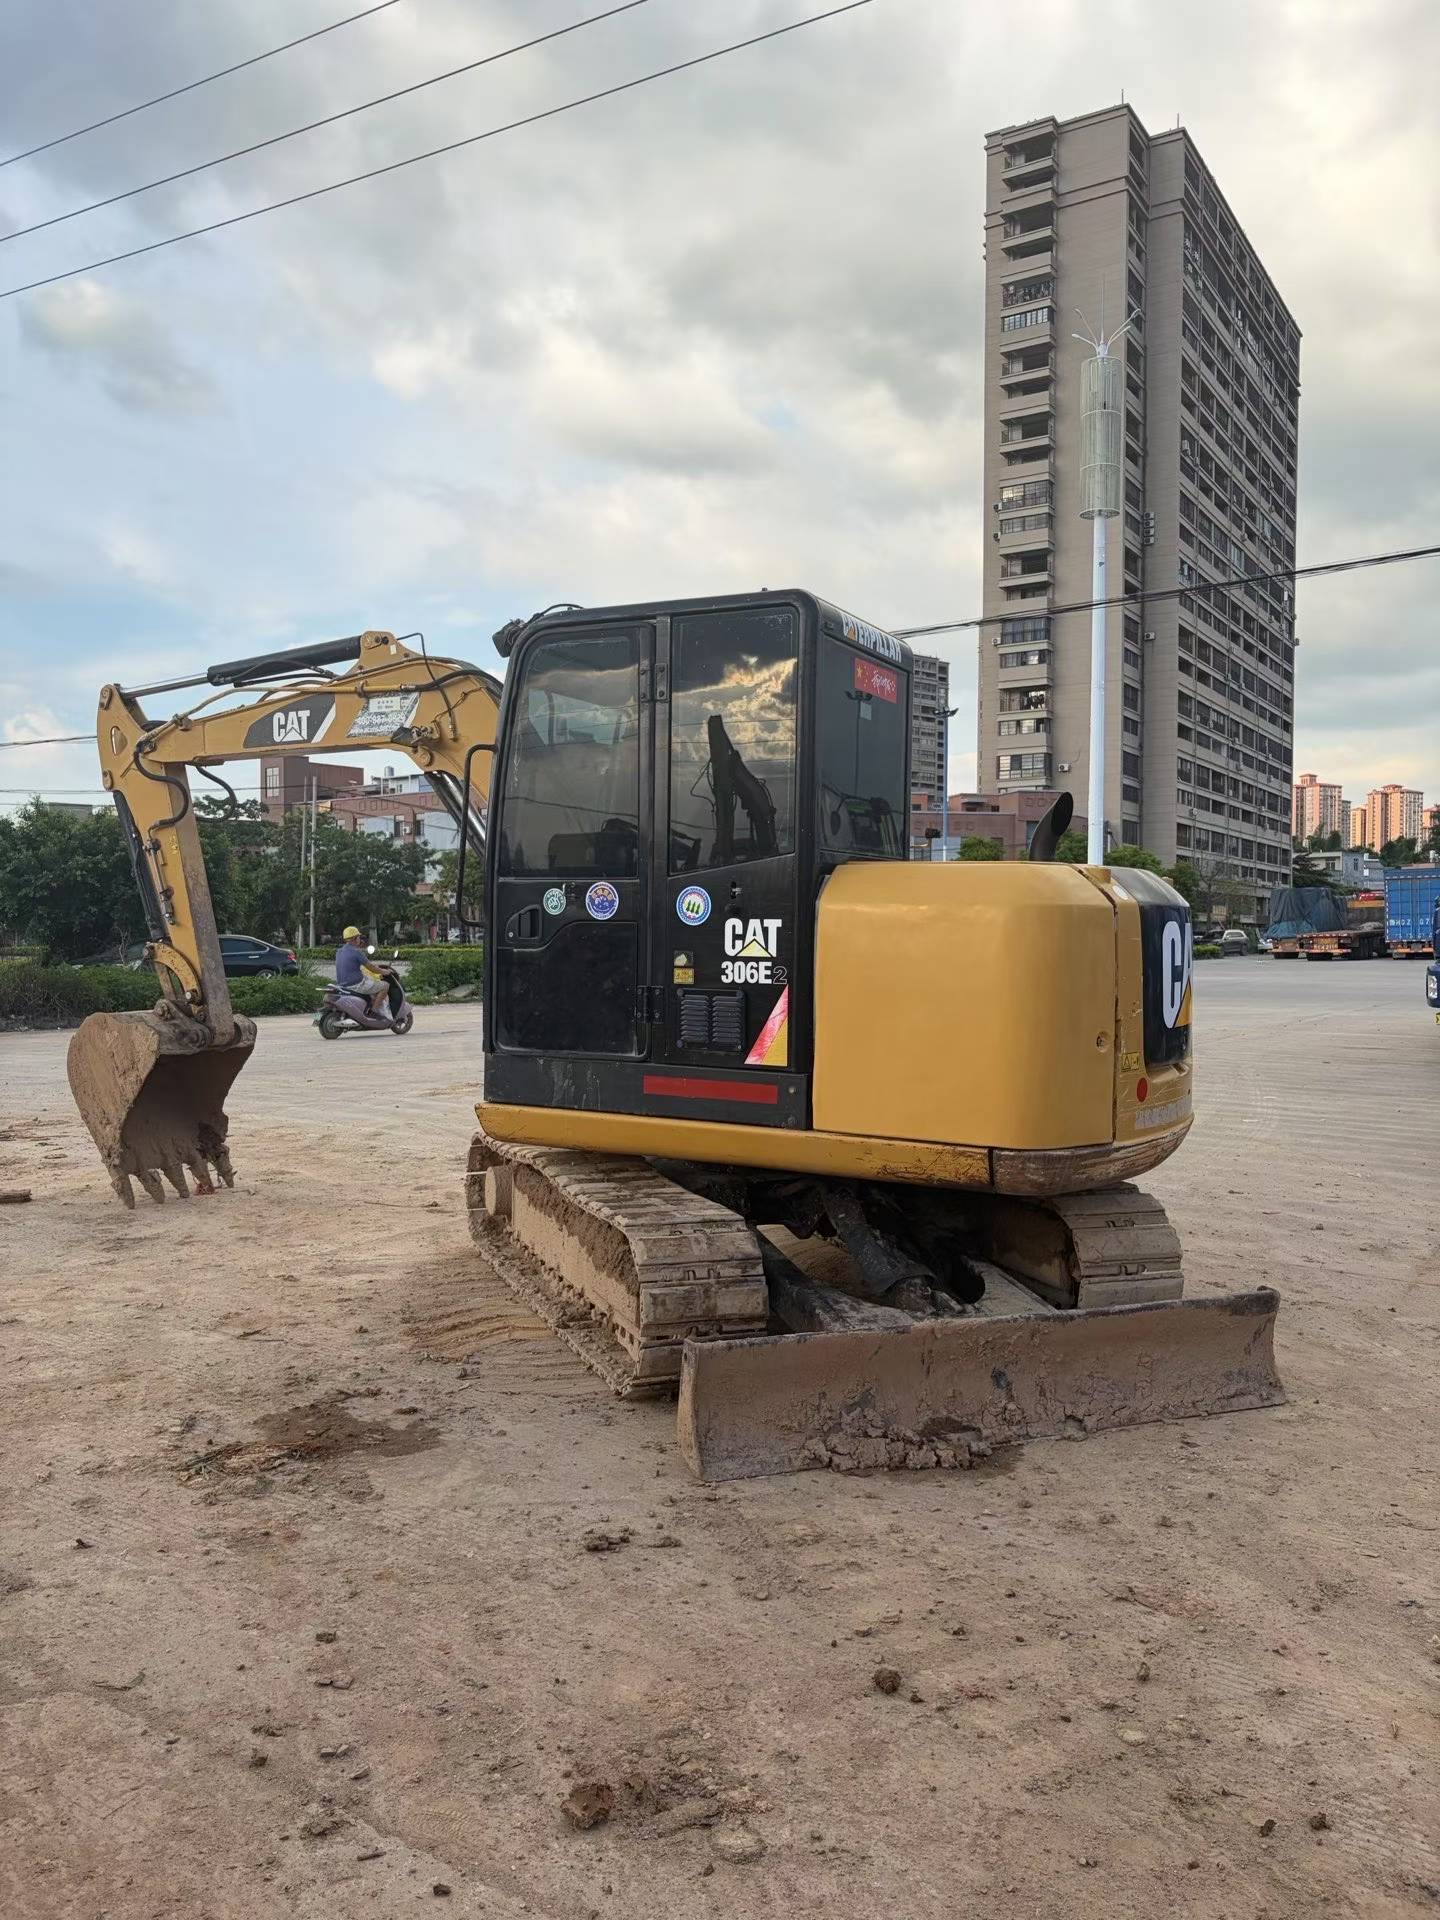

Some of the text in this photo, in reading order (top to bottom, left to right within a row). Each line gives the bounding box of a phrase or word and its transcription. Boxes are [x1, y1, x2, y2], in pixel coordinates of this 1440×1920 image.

[841, 614, 902, 663] CATERPILLAR
[272, 709, 311, 742] CAT
[724, 918, 783, 957] CAT
[721, 961, 788, 985] 306E2
